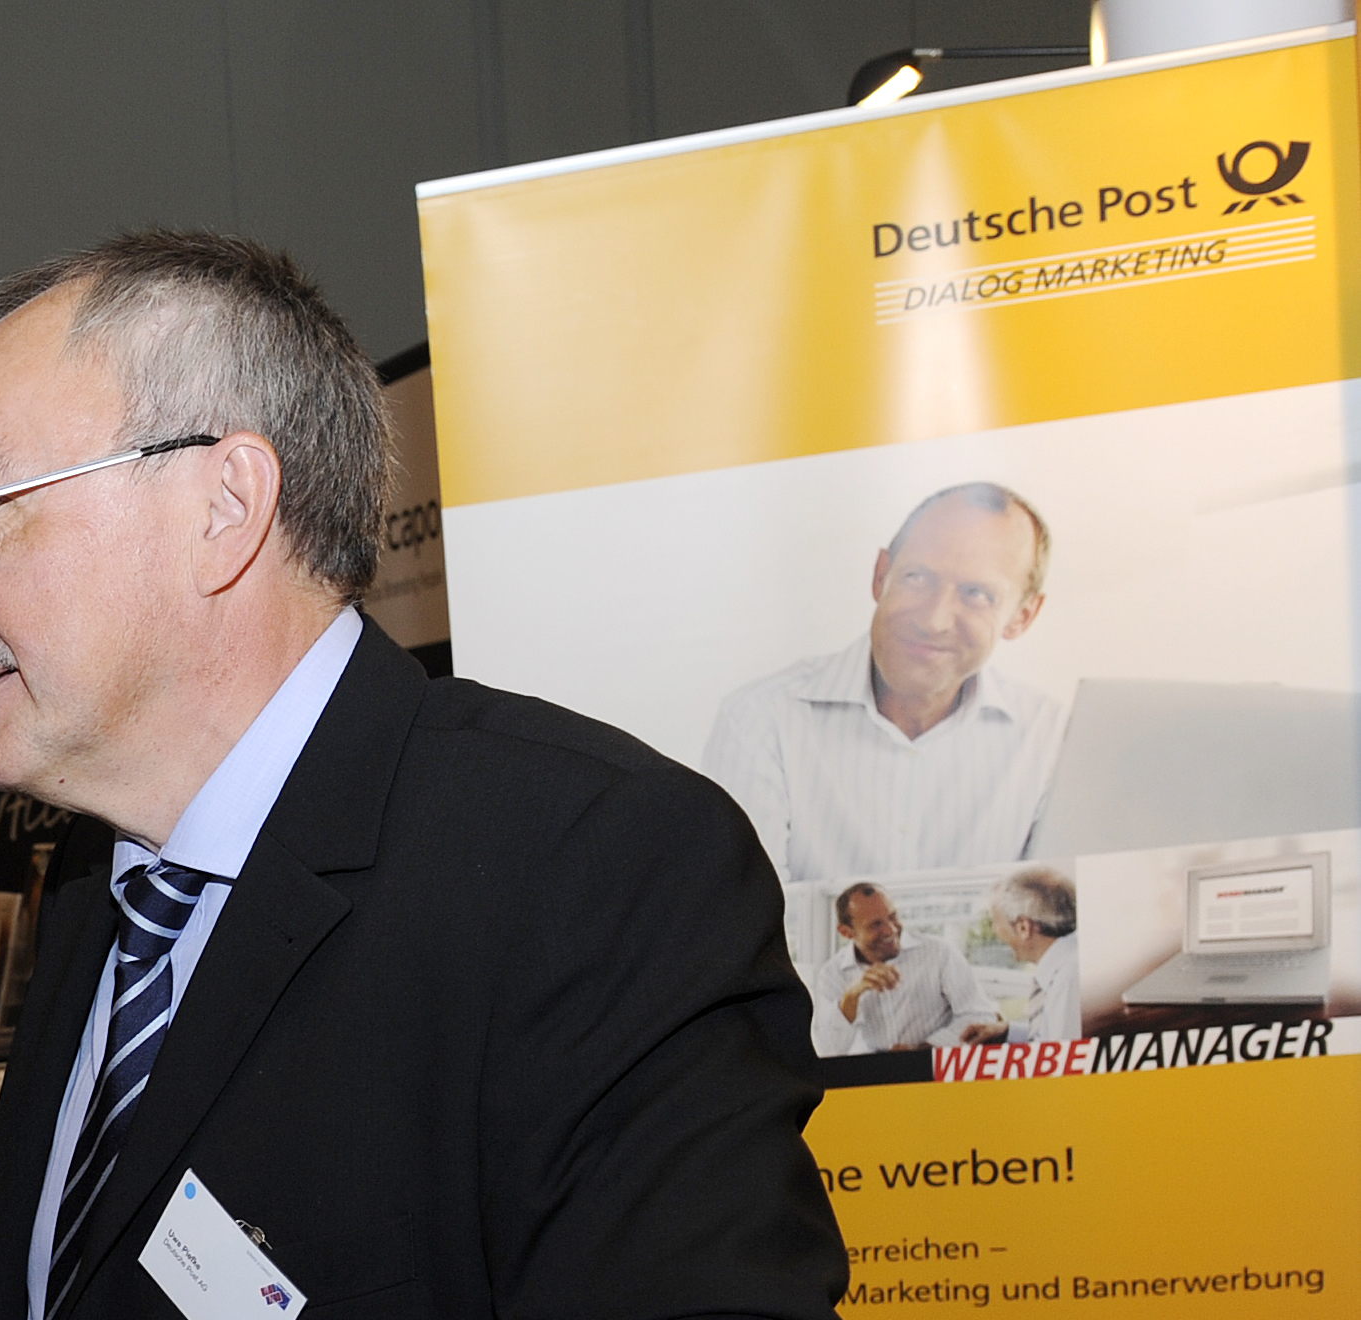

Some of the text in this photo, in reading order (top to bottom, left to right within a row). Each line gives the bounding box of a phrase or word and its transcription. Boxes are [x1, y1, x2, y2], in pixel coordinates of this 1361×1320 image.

[873, 175, 1197, 260] Deutsche Post
[903, 240, 1226, 311] DIALOG MARKETING
[932, 1020, 1334, 1082] WERBEMANAGER
[880, 1147, 1075, 1191] werben!
[846, 1236, 979, 1264] erreichen
[840, 1266, 1325, 1306] Marketing und Bannerwerbung
